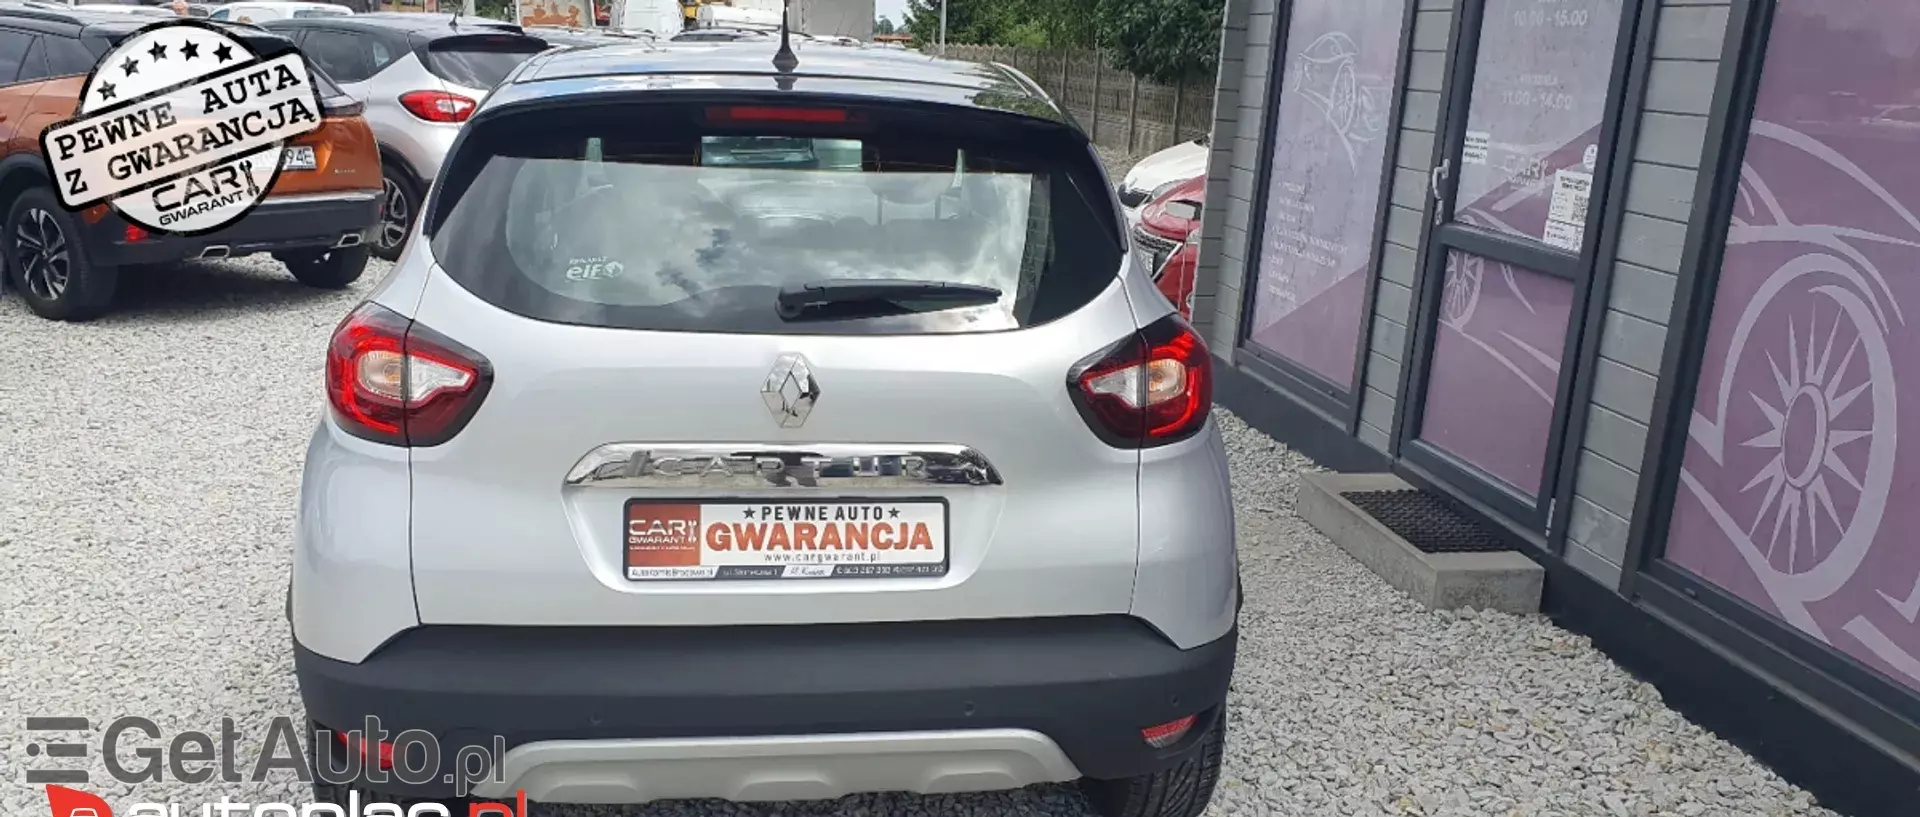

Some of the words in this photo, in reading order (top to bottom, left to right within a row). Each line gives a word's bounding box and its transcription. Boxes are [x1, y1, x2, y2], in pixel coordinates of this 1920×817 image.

[761, 506, 828, 521] PEWNE
[835, 506, 883, 521] AUTO
[629, 519, 687, 536] CAR
[629, 536, 686, 545] GWARANT
[706, 522, 934, 552] GWARANCJA
[764, 552, 881, 563] www.cargwarant.pl
